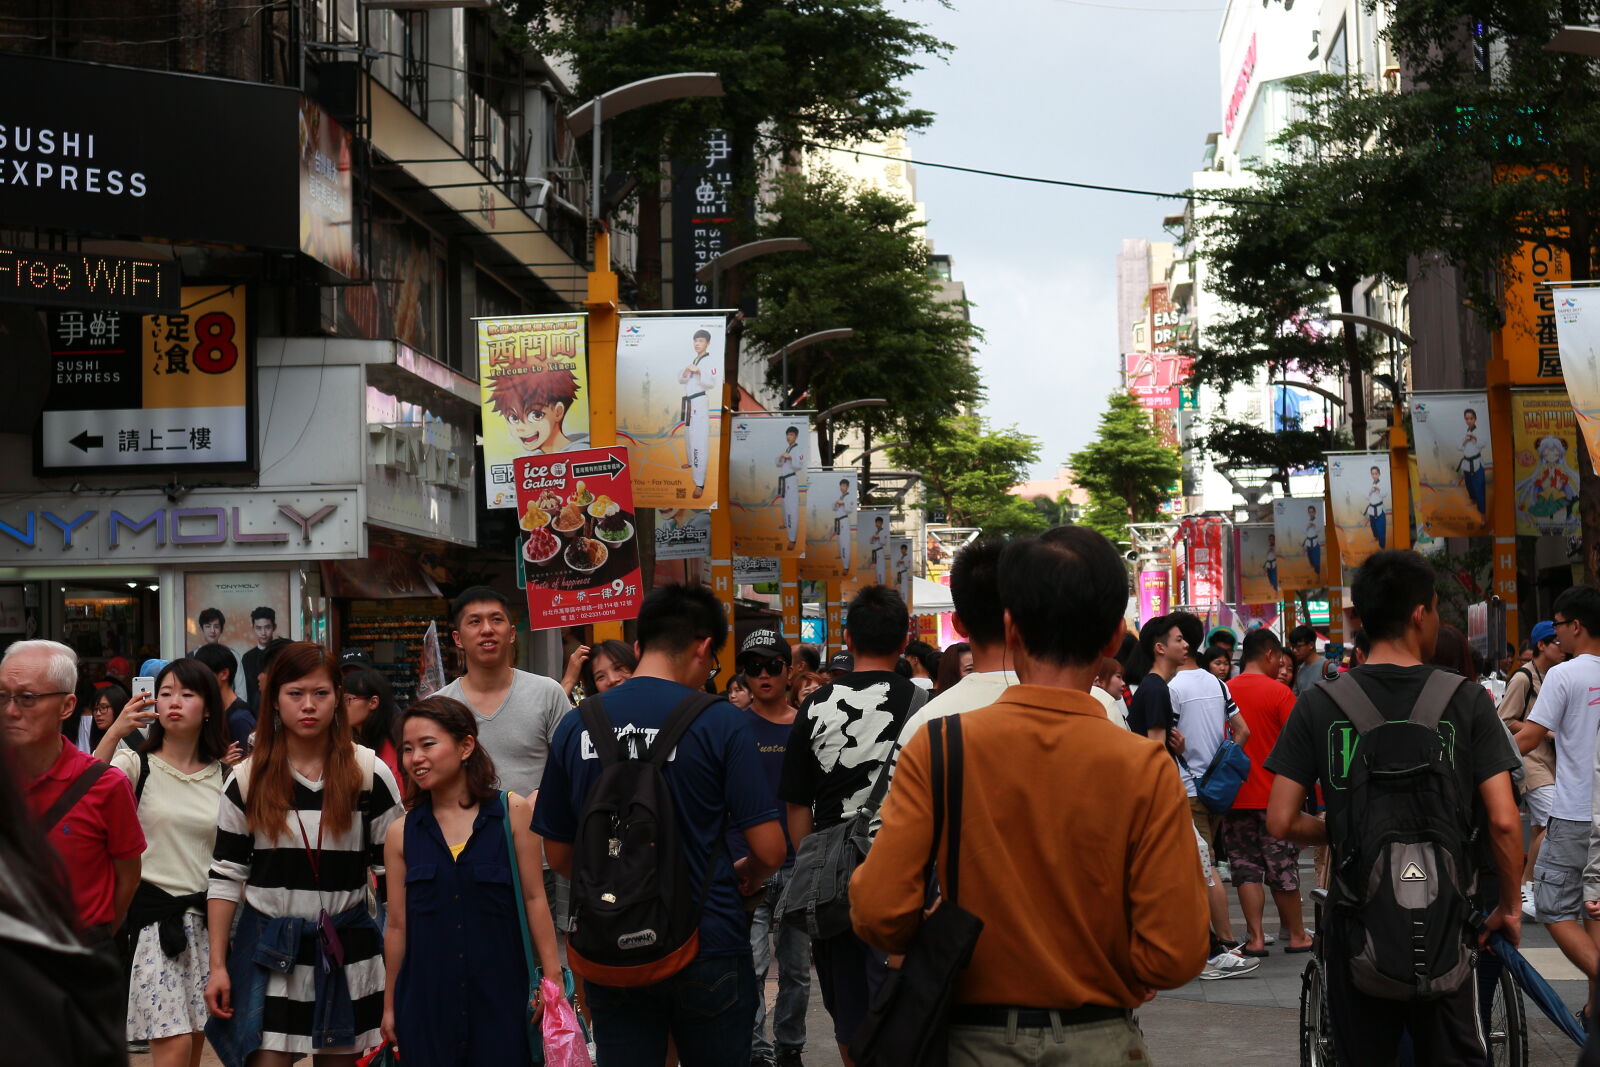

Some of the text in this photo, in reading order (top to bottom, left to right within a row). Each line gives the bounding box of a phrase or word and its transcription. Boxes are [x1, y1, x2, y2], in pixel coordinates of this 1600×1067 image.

[709, 229, 722, 260] SUS
[694, 229, 708, 306] EXPRSS
[84, 257, 161, 299] WiFi
[487, 331, 580, 367] 西門町
[57, 360, 99, 371] SUSHI
[490, 361, 577, 378] Welcome to Ximen
[57, 372, 121, 384] EXPRESS
[118, 427, 212, 453] 請上二樓
[523, 462, 549, 479] ice
[522, 477, 567, 490] Galaxy
[1499, 554, 1513, 569] H
[715, 576, 728, 591] H
[785, 595, 795, 607] H
[783, 615, 797, 625] 18
